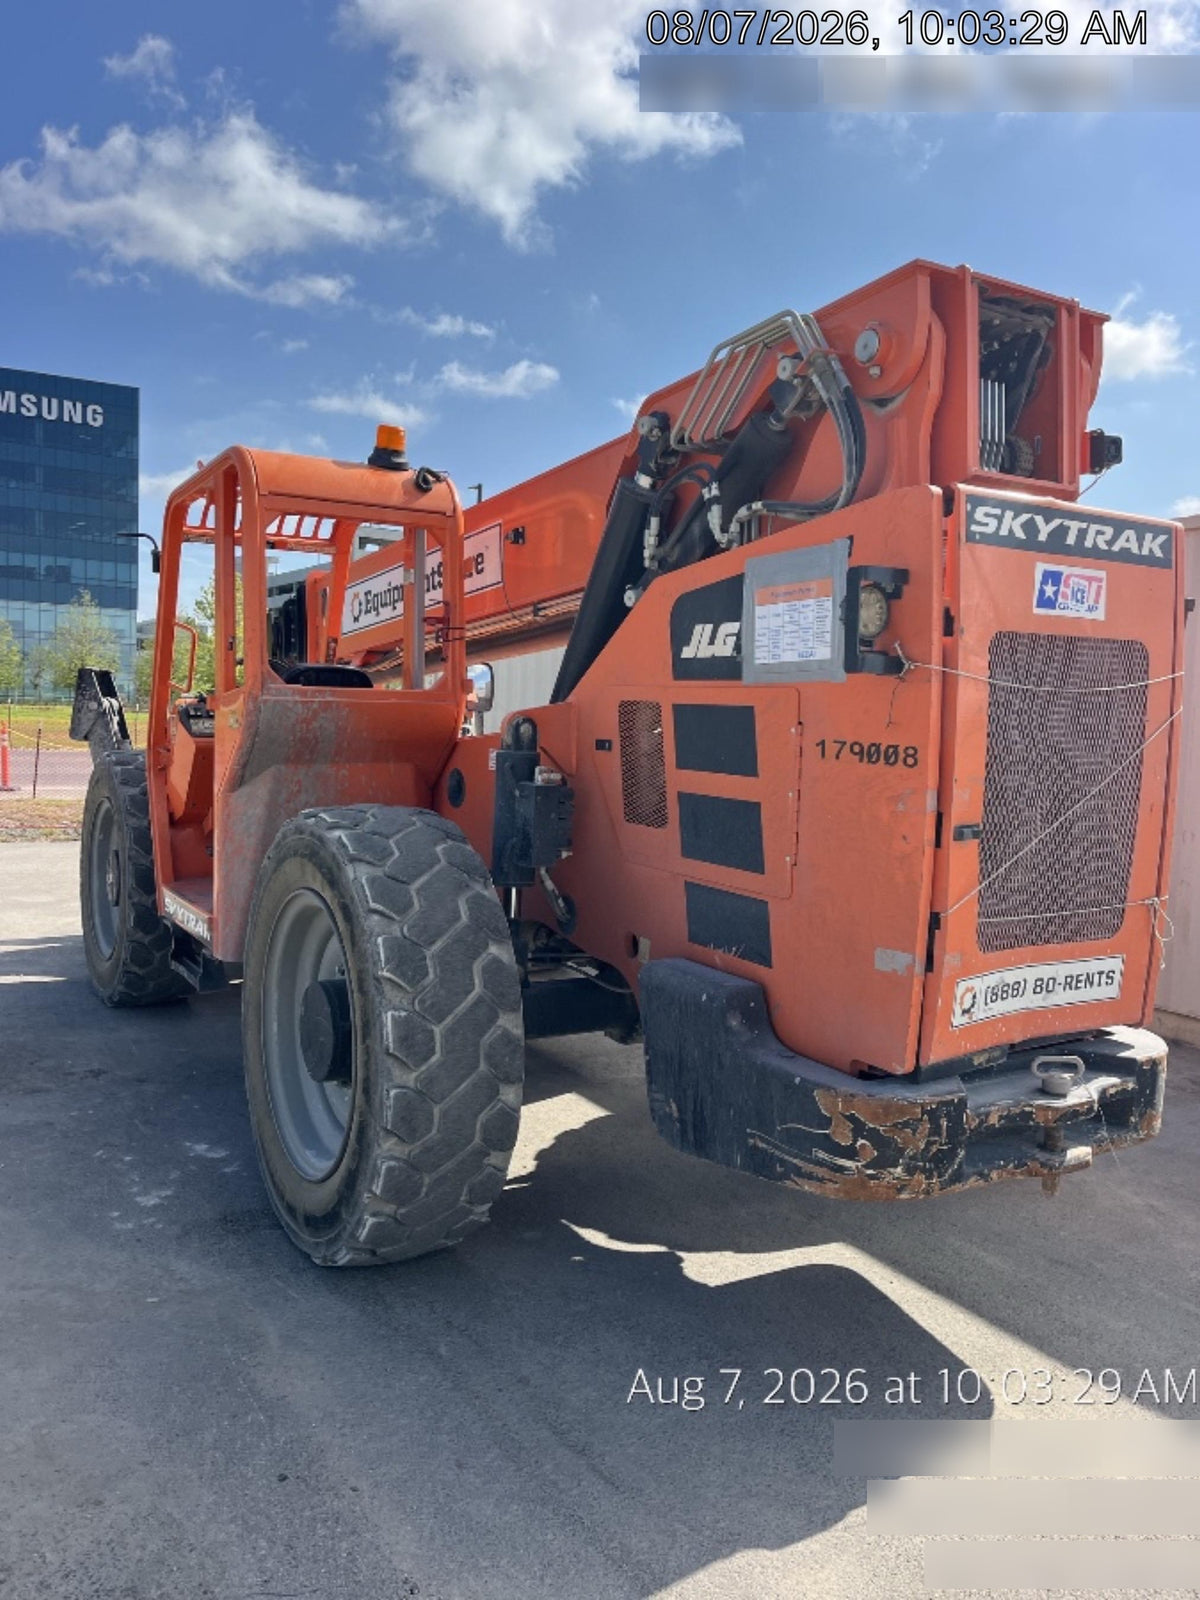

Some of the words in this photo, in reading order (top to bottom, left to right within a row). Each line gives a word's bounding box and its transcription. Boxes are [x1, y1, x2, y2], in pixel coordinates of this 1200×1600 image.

[969, 505, 1169, 558] SKYTRAK
[680, 621, 741, 659] JLG
[815, 738, 919, 769] 179008
[984, 977, 1028, 1007] (888)
[1032, 969, 1116, 996] 80-RENTS
